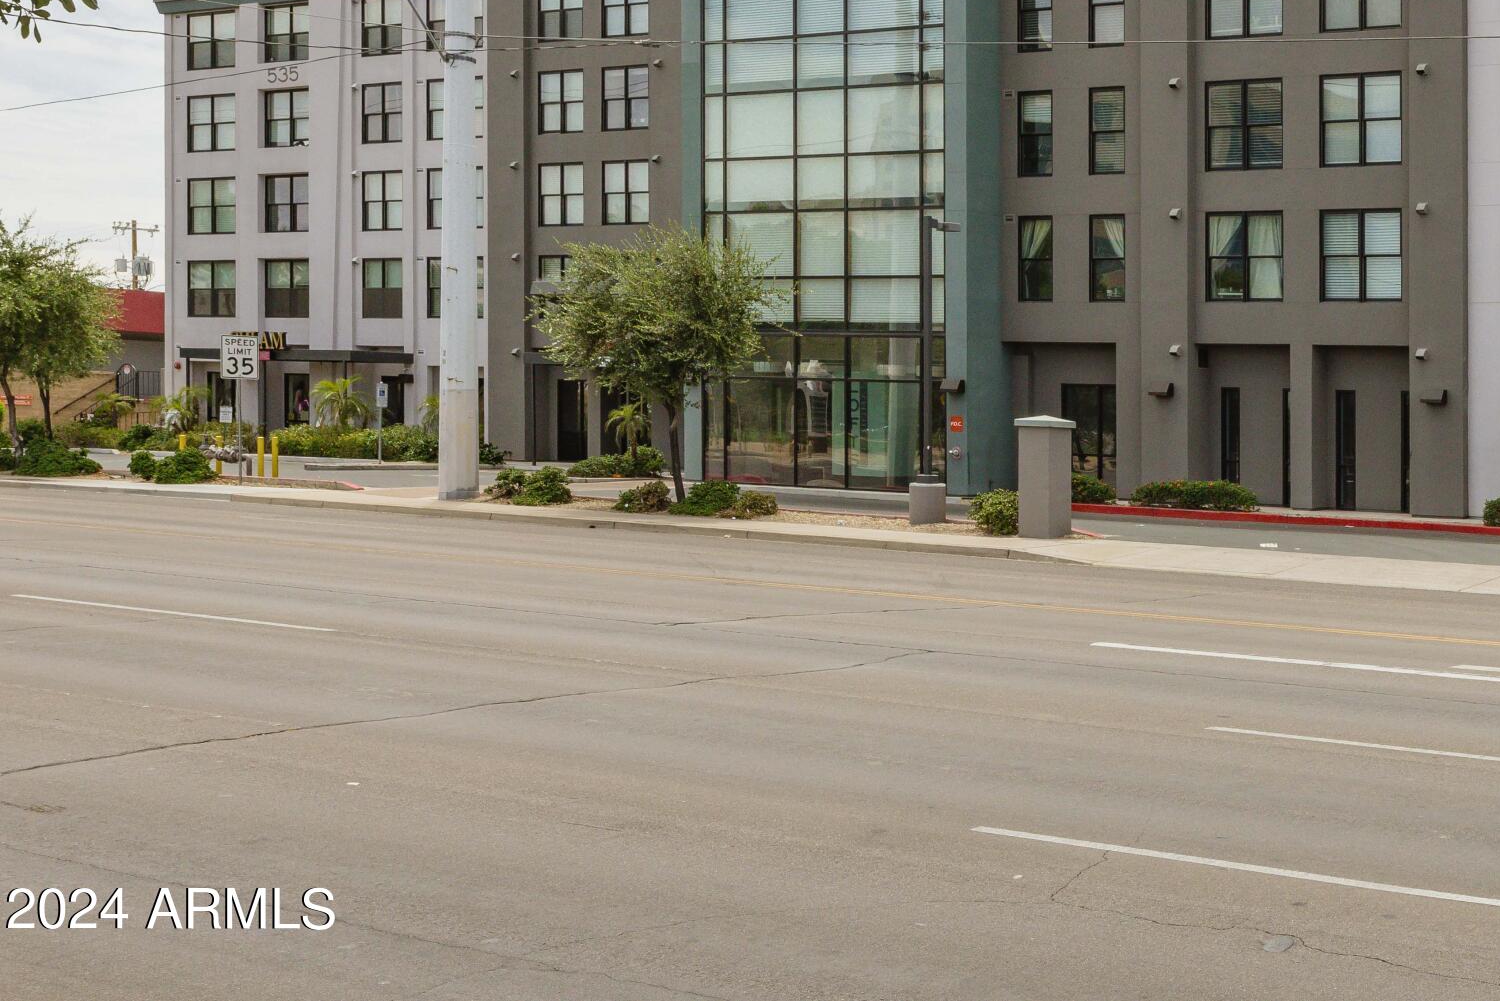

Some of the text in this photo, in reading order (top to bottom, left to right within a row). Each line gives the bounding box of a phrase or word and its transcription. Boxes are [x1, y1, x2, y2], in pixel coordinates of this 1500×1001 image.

[267, 66, 299, 83] 535
[224, 338, 256, 347] SPEED
[226, 356, 254, 375] 35
